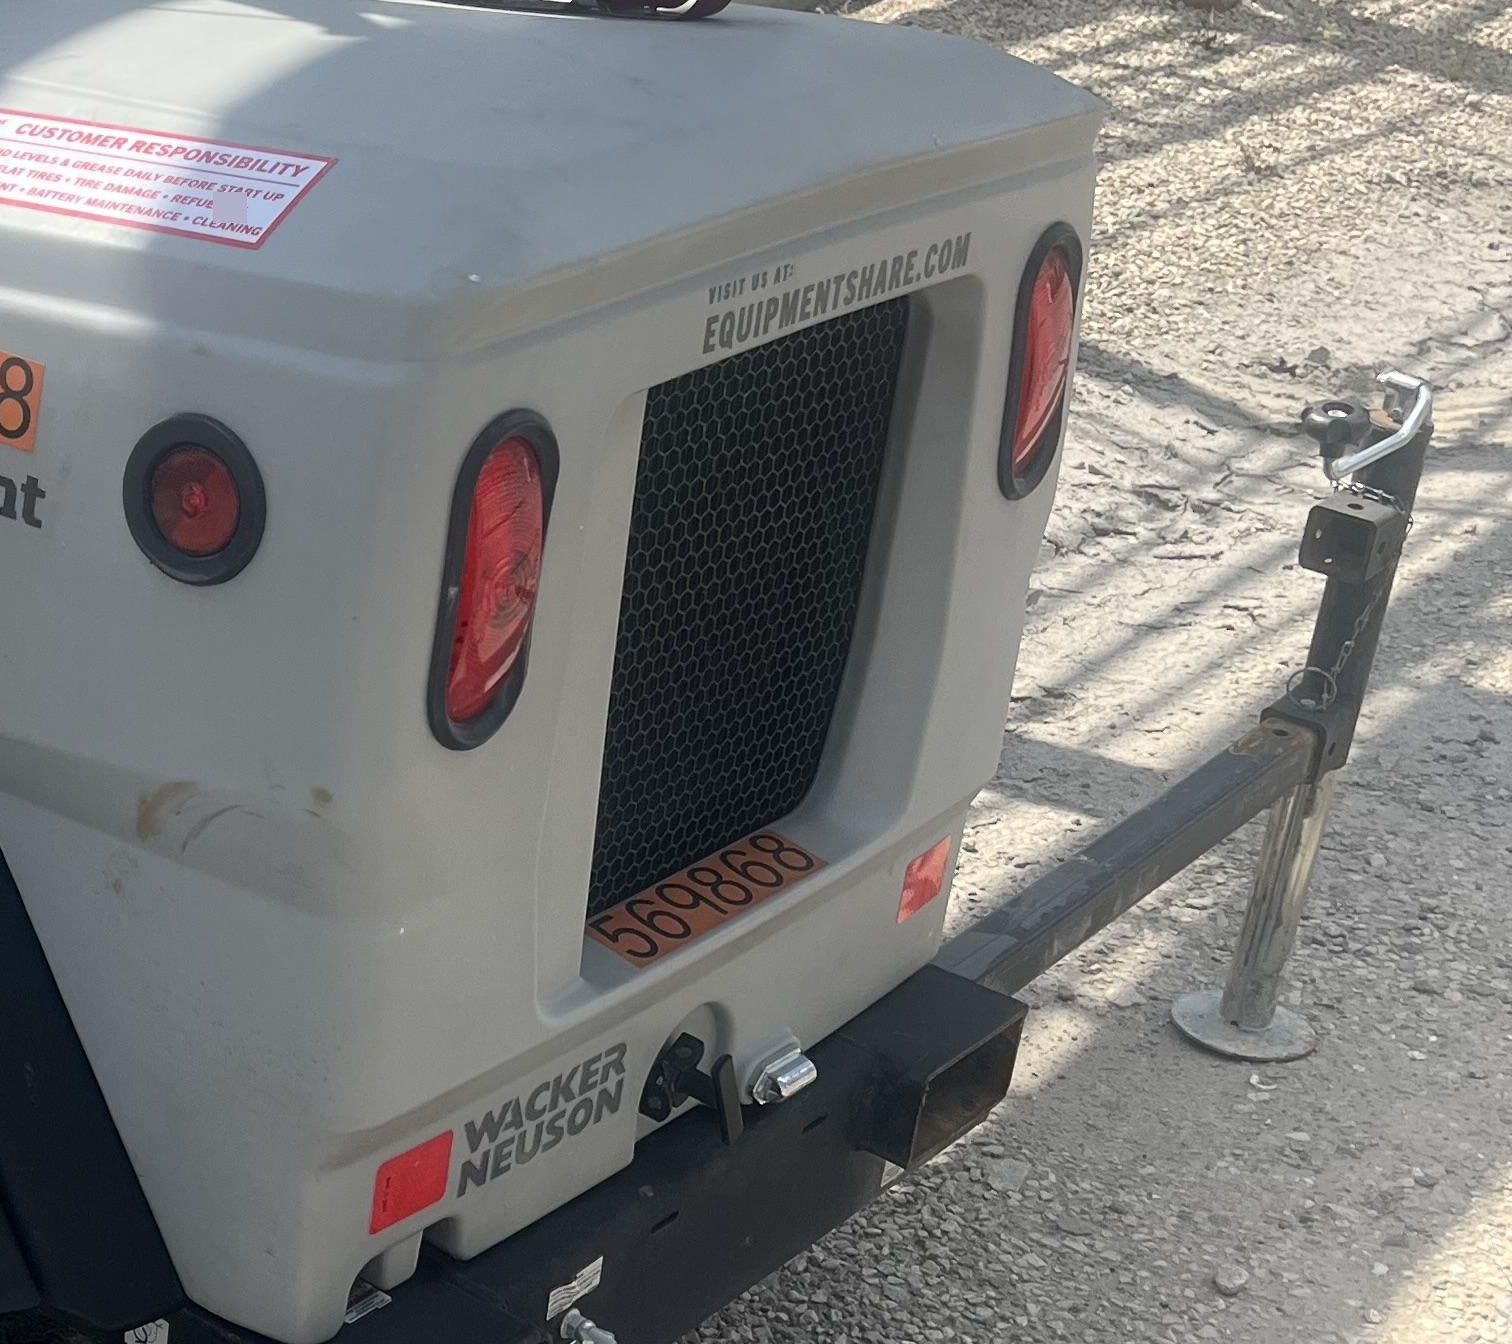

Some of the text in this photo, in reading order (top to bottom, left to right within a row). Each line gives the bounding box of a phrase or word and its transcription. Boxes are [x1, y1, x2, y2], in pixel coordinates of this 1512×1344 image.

[11, 150, 58, 165] LEVELS
[59, 158, 70, 167] &
[71, 160, 123, 175] GREASE
[123, 168, 161, 182] DAILY
[162, 175, 218, 191] BEFORE
[218, 184, 261, 199] START
[262, 192, 285, 202] UP
[14, 122, 311, 178] CUSTOMER RESPONSIBILITY
[26, 187, 82, 203] BATTERY
[83, 197, 184, 223] MAINTENANCE
[191, 215, 263, 237] CLEANING
[27, 169, 63, 182] TIRES
[73, 177, 102, 190] TIRE
[104, 182, 159, 200] DAMAGE
[702, 232, 972, 354] EQUIPMENTSHARE.COM
[708, 263, 795, 305] VISIT US AT:
[588, 834, 815, 958] 569868
[464, 1042, 628, 1154] WACKER
[456, 1077, 625, 1199] NEUSON
